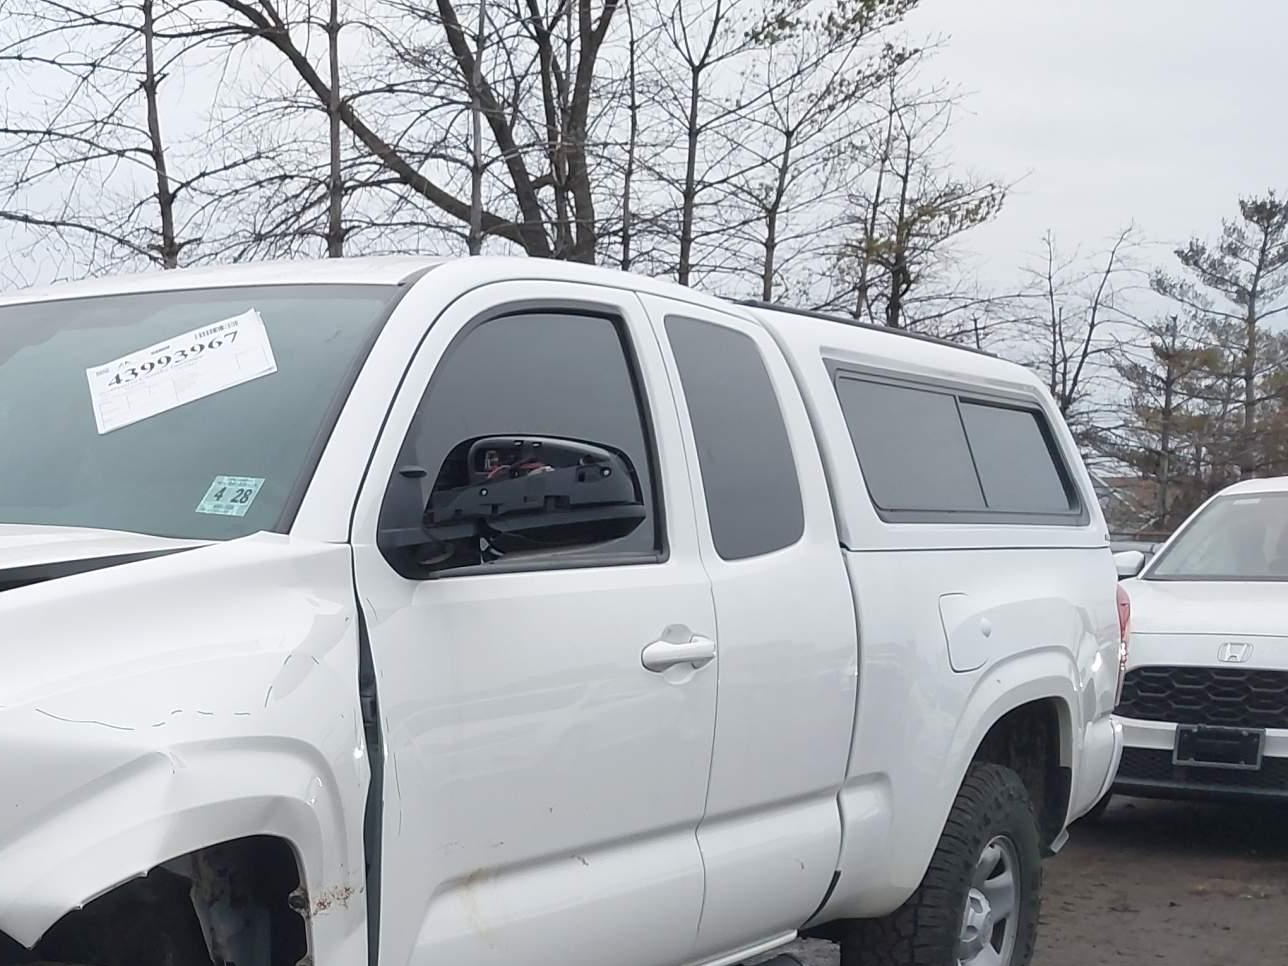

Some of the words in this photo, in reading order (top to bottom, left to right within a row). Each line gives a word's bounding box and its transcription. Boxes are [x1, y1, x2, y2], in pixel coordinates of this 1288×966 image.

[107, 330, 239, 387] 43993967
[214, 486, 227, 502] 4
[230, 487, 253, 504] 28
